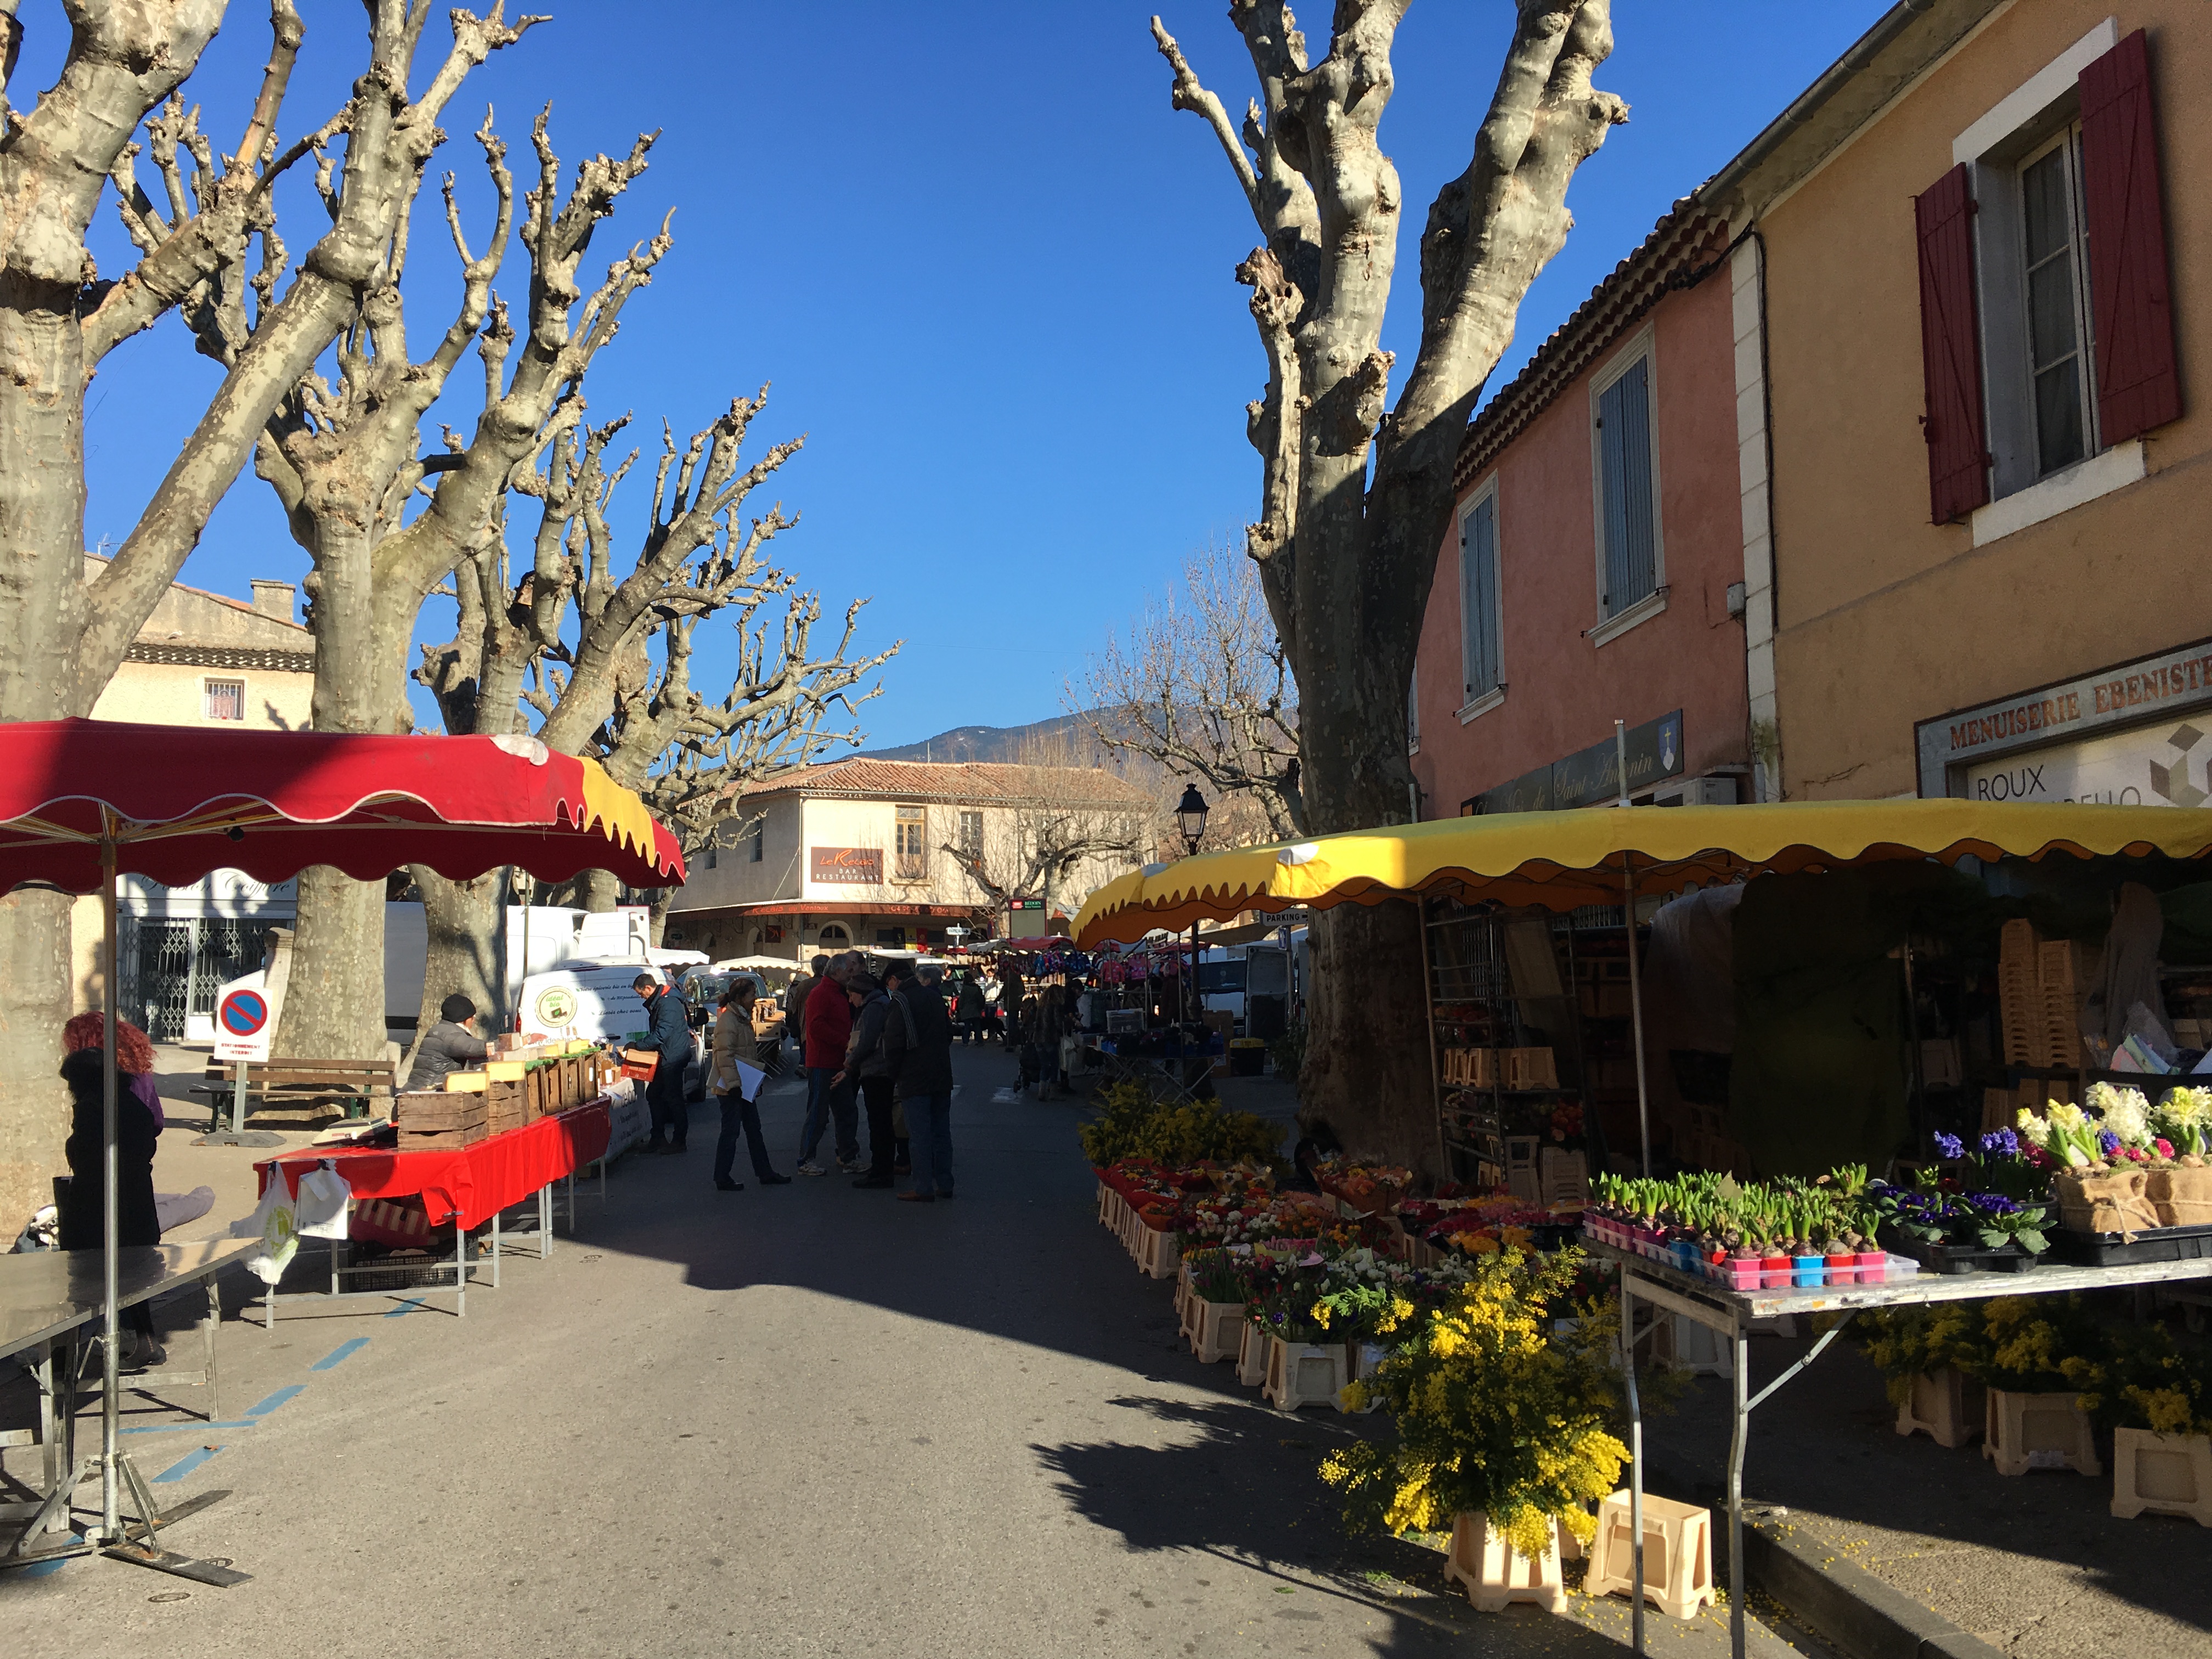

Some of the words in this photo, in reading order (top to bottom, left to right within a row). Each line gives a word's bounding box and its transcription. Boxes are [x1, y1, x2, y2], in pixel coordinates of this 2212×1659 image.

[1949, 692, 2081, 751] MENUISERIE
[1593, 751, 1653, 790] Annin
[1977, 764, 2047, 802] ROUX
[816, 873, 879, 882] RESTAURANT
[1266, 913, 1300, 922] PARKING
[545, 994, 564, 1002] idéal
